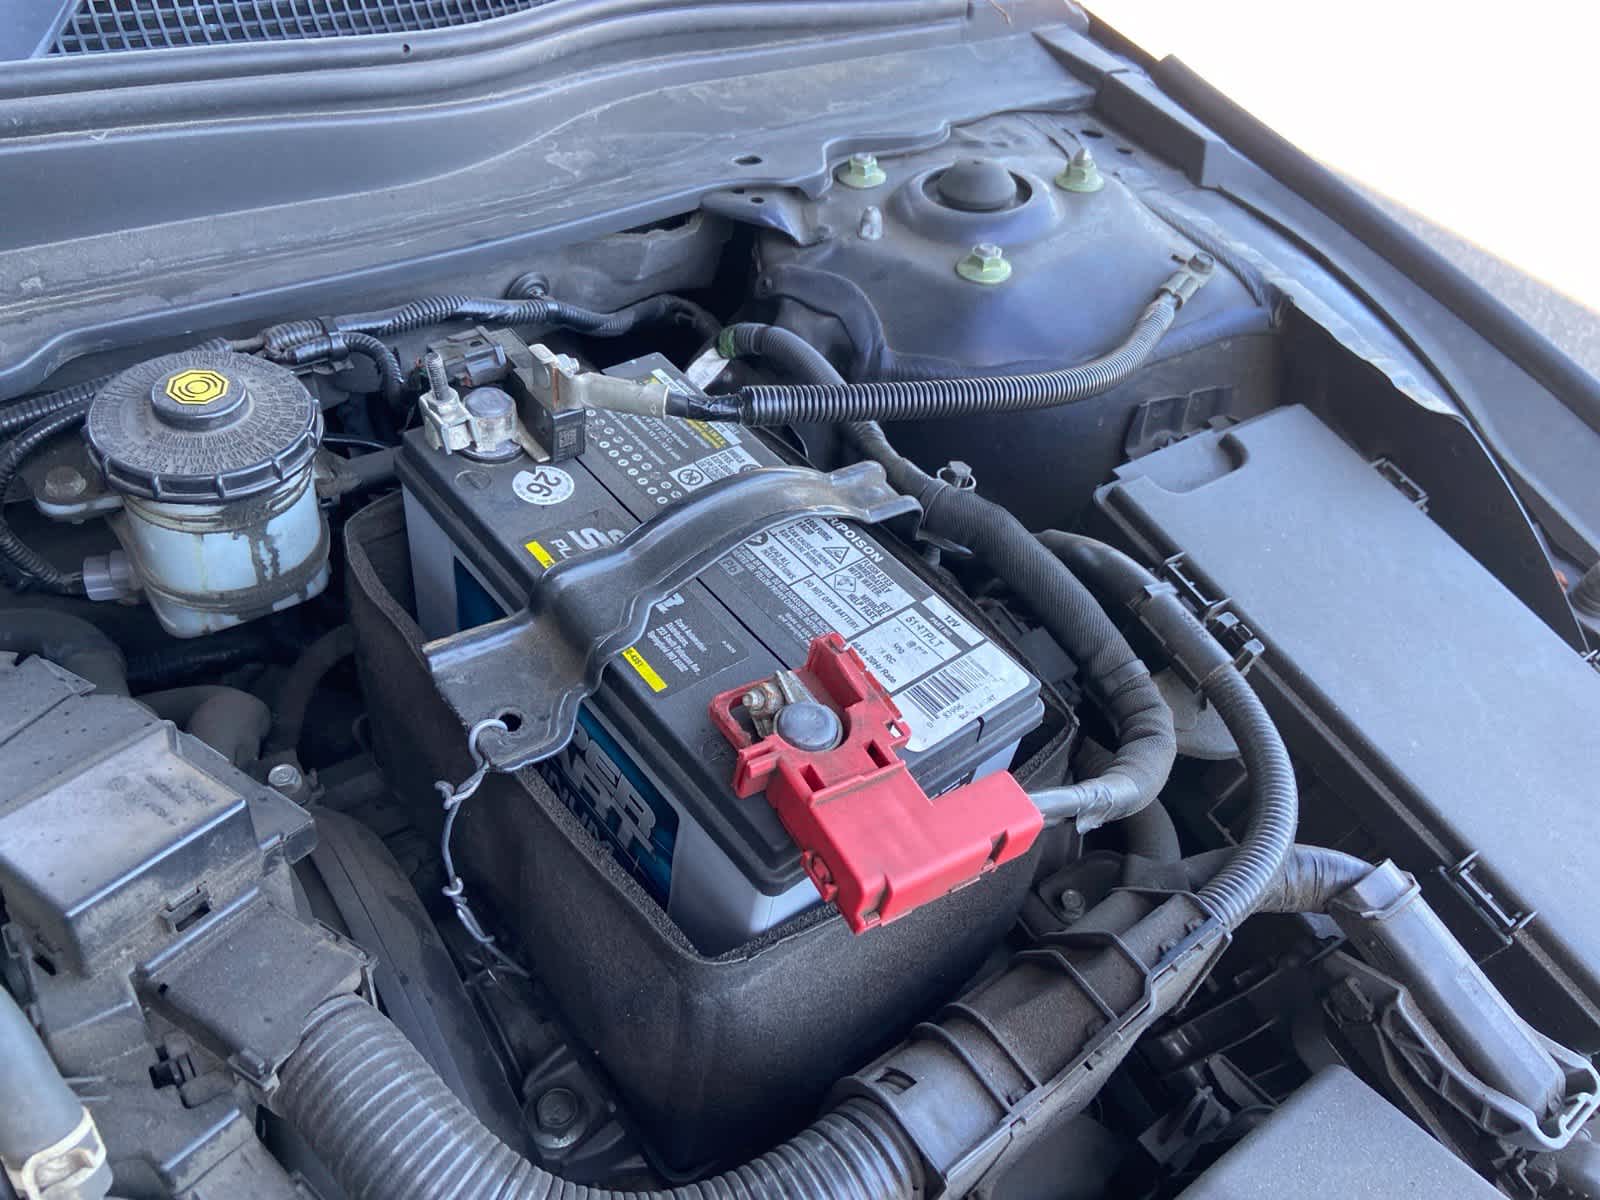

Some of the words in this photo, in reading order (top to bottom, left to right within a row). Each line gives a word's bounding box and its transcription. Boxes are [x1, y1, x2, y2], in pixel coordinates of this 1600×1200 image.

[527, 471, 562, 497] 26
[720, 558, 740, 573] Pb
[853, 562, 892, 594] IMMEDIATELY
[860, 559, 881, 575] FLUSH
[876, 573, 895, 587] EYES
[846, 565, 865, 580] WITH
[860, 577, 884, 597] WATER.
[820, 595, 838, 610] OPEN
[833, 607, 862, 631] BATTERY.
[845, 592, 864, 607] HELP
[859, 604, 879, 621] FAST.
[858, 593, 887, 617] MEDICAL
[878, 601, 894, 613] GET
[942, 614, 961, 629] 12V
